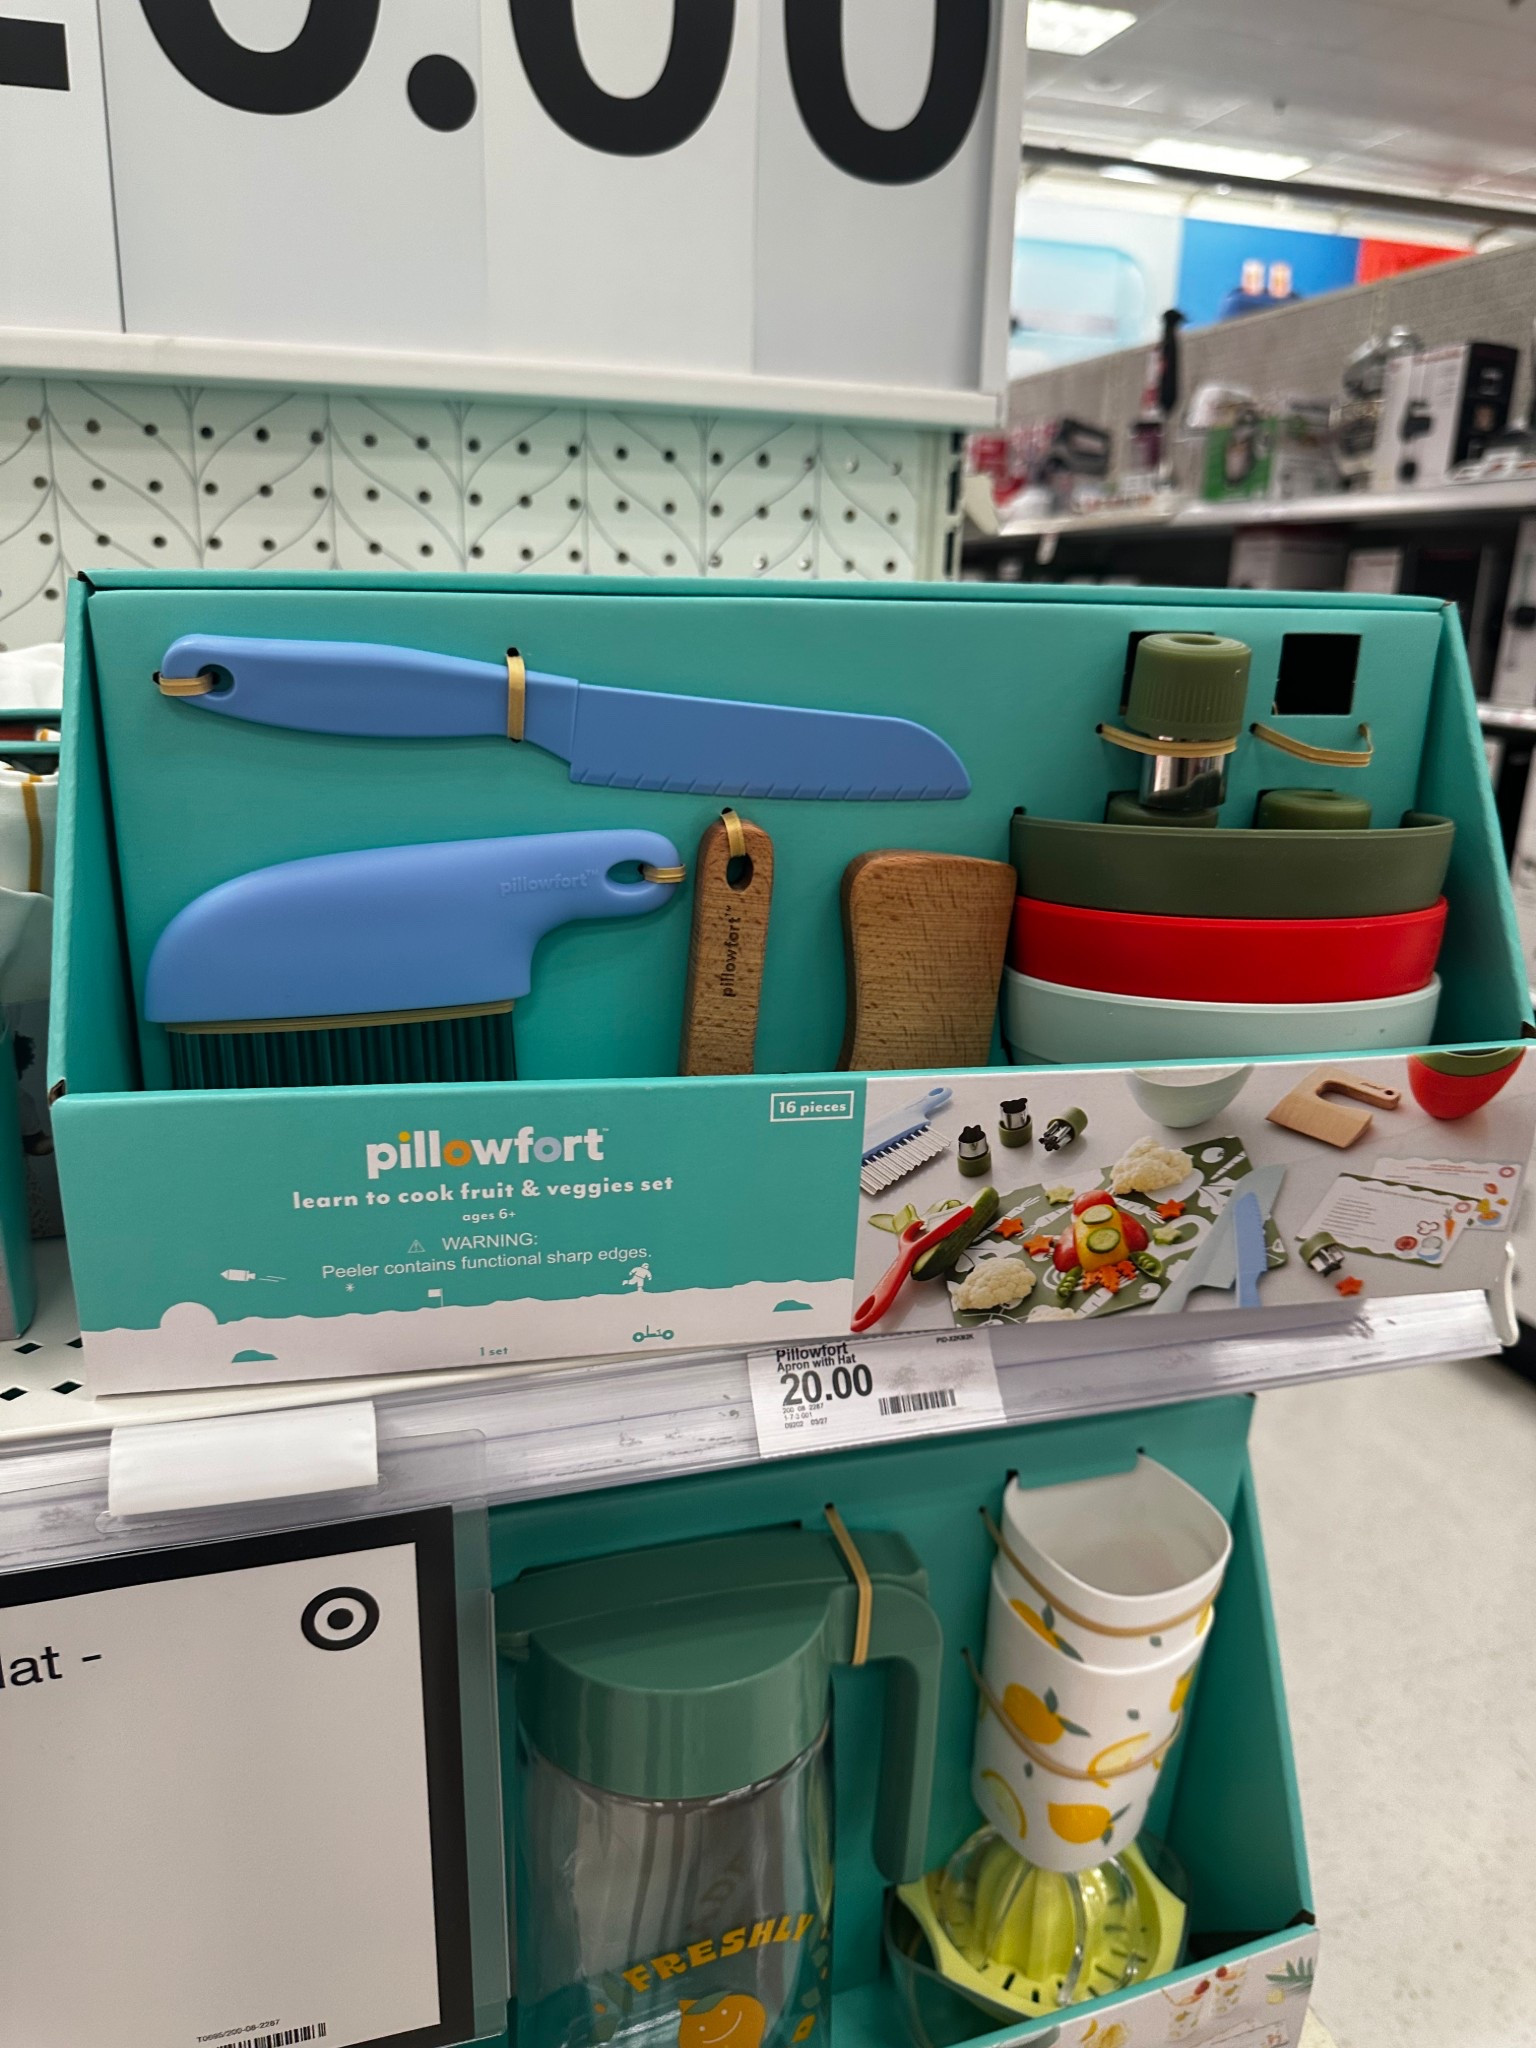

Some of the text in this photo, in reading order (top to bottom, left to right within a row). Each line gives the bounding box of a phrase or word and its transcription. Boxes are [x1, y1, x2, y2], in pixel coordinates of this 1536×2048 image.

[778, 1099, 847, 1116] 16 pieces
[293, 1176, 675, 1209] learn to cook fruit & veggies set
[462, 1208, 517, 1224] ages 6+
[441, 1232, 539, 1251] WARNING:
[321, 1246, 652, 1279] Peeler contains functional sharp edges.
[479, 1346, 509, 1356] 1 set
[776, 1342, 848, 1362] Pillowfort
[777, 1354, 856, 1374] Apron with Hat
[780, 1364, 873, 1407] 20.00
[0, 1646, 63, 1689] at
[622, 1913, 815, 1993] FRESHLY
